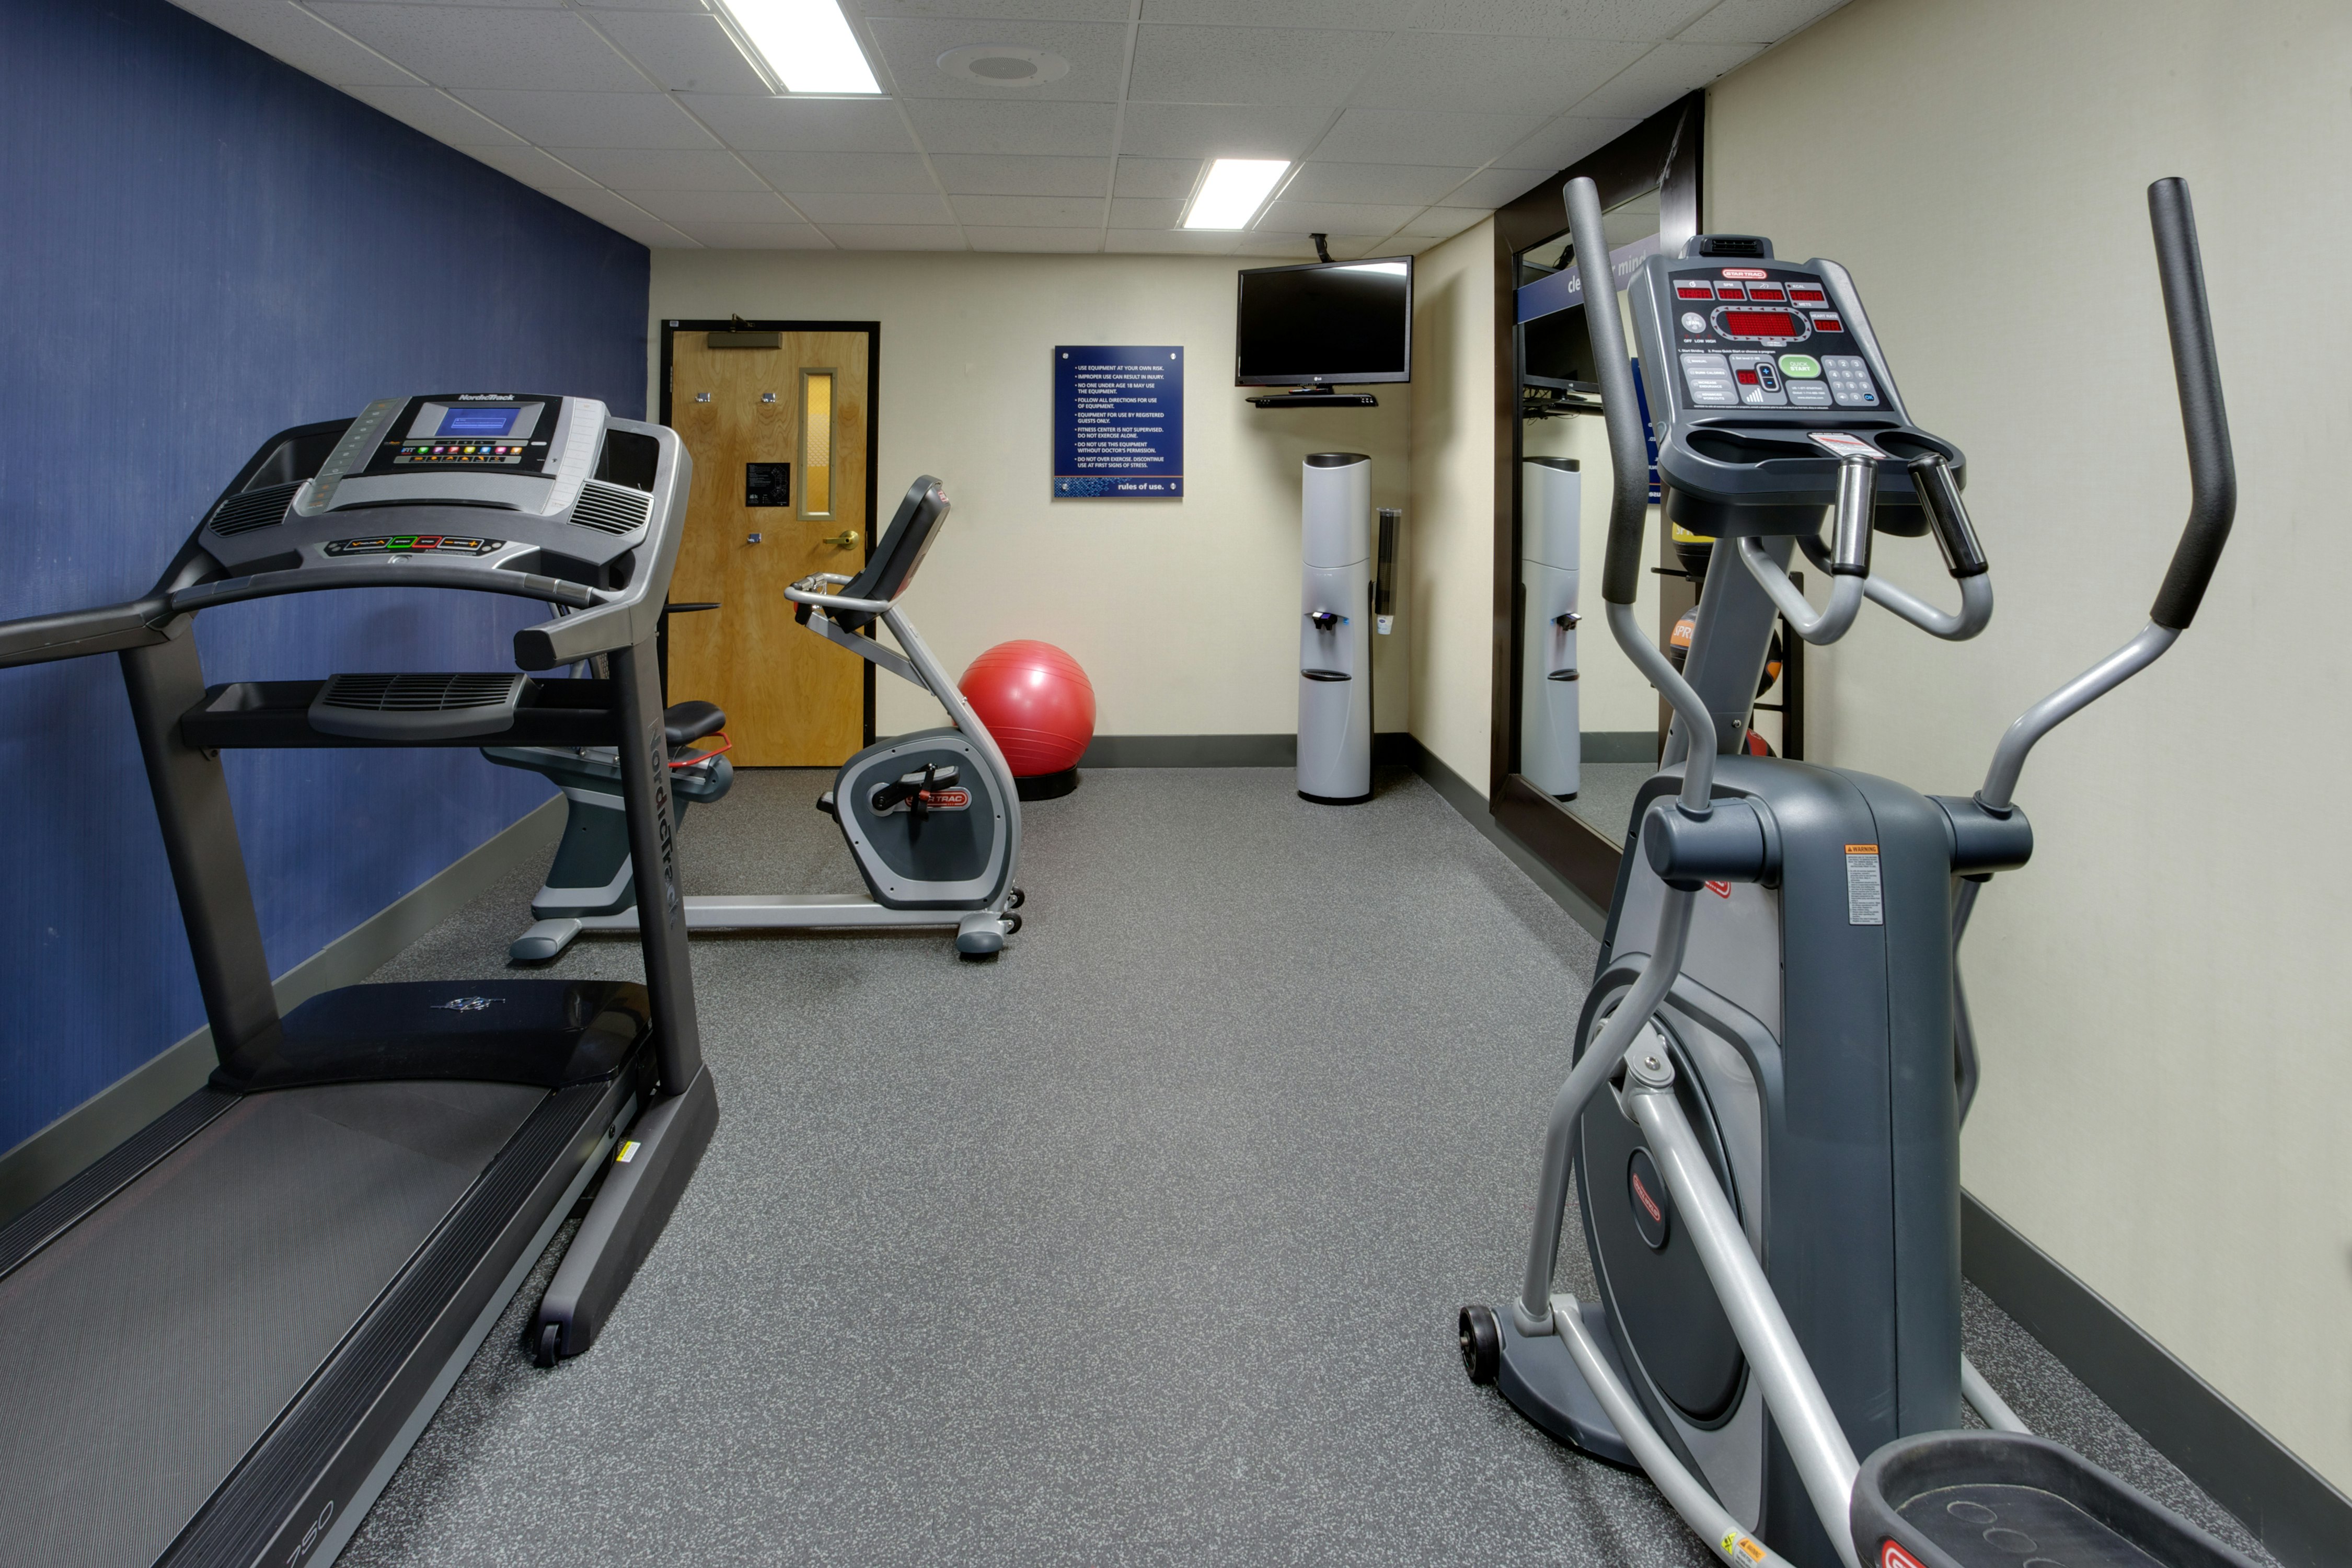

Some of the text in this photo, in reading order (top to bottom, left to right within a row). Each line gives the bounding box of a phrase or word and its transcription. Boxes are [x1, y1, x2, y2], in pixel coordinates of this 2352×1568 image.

[648, 717, 680, 925] NordicTrack
[1634, 1180, 1658, 1217] STAR TRAC
